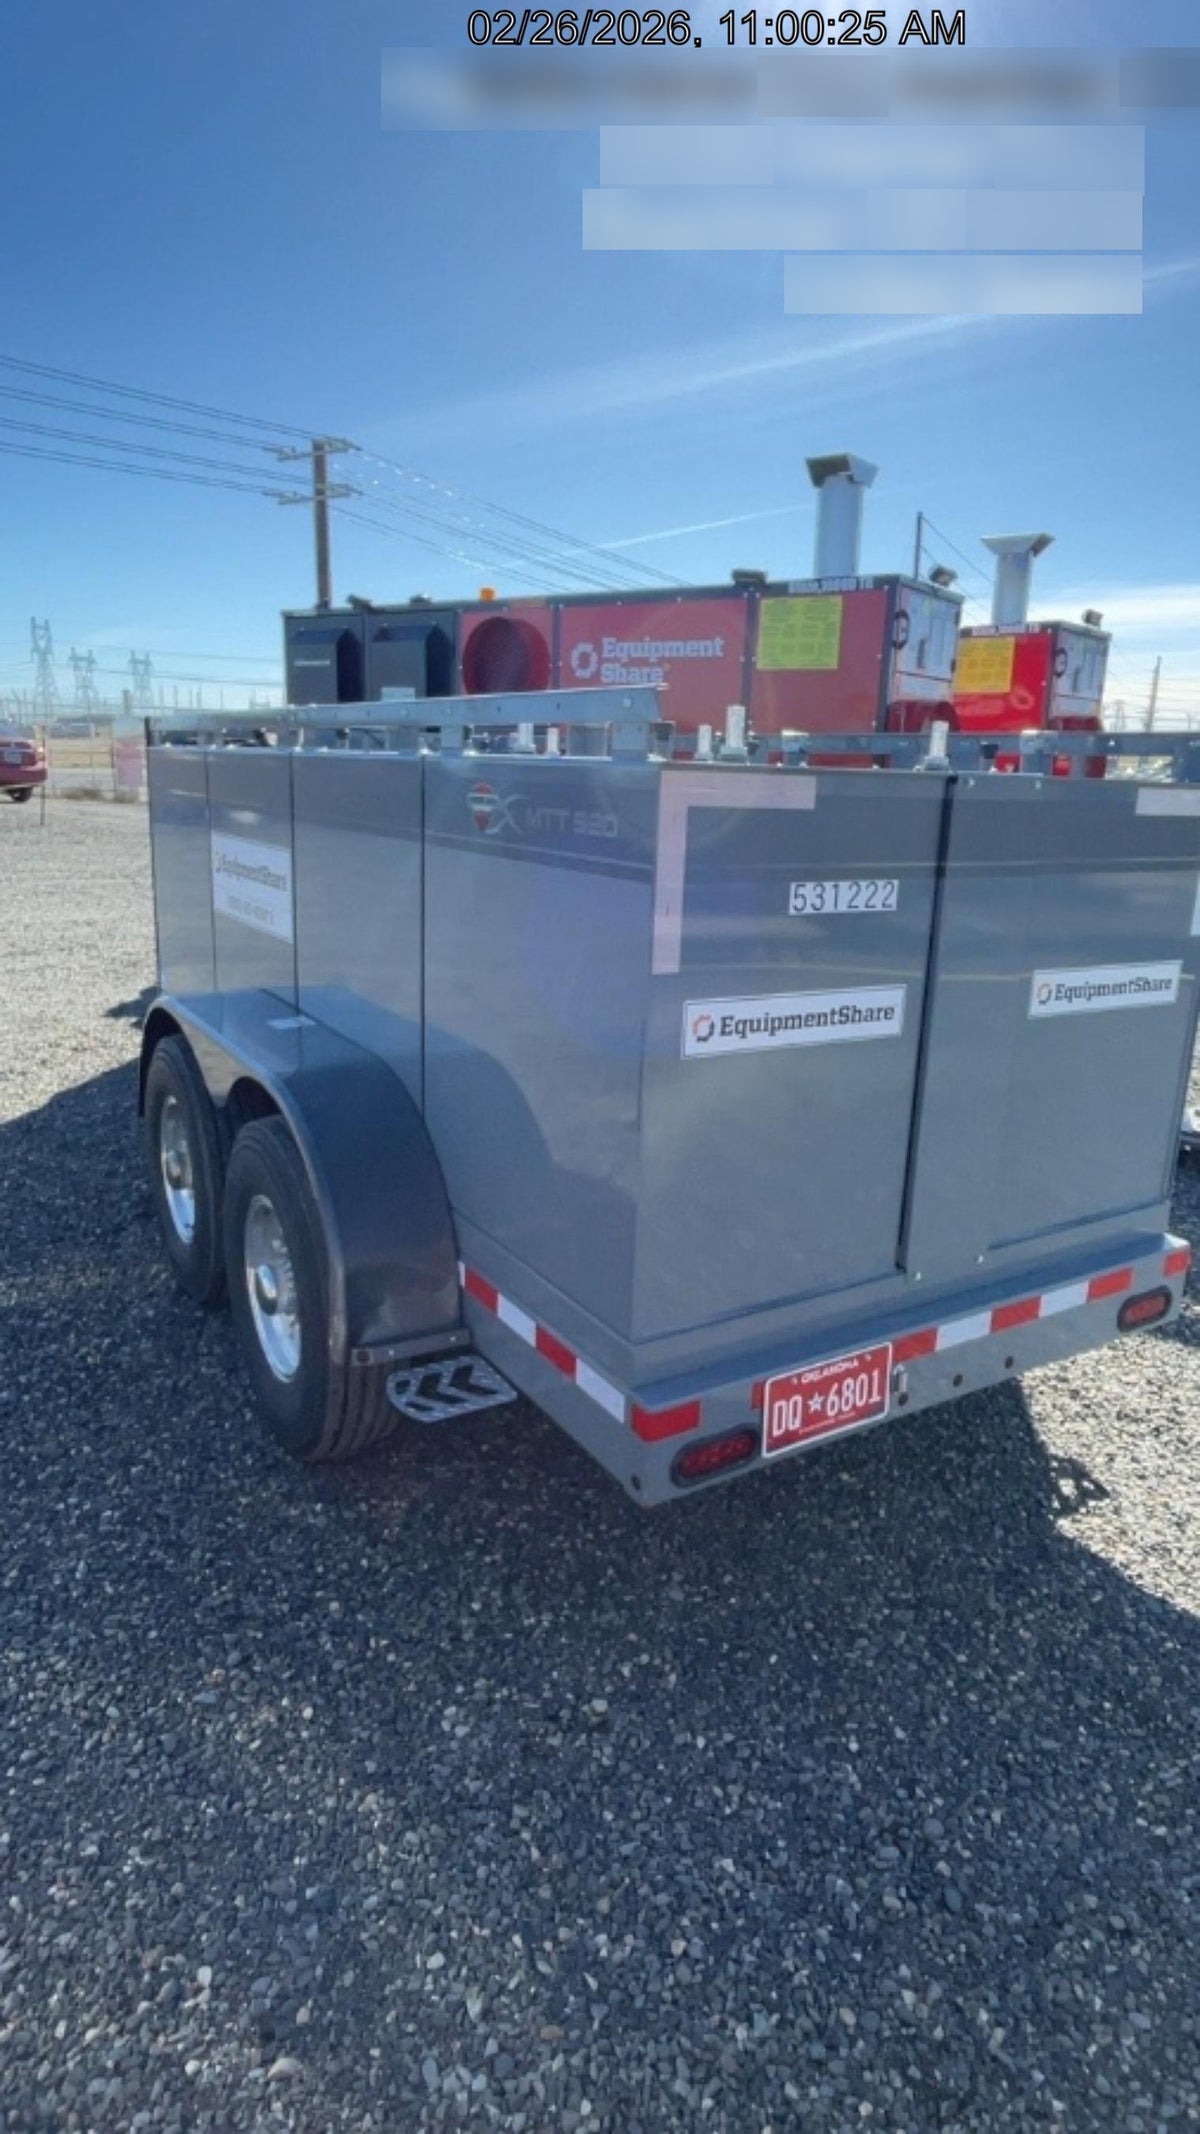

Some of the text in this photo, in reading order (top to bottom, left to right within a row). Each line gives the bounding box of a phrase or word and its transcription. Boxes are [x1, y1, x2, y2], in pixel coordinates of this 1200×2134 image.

[601, 637, 724, 662] Equipment
[601, 663, 665, 683] Share
[791, 880, 897, 913] 531222
[1053, 976, 1173, 1002] EquipmentShare
[719, 1004, 895, 1038] EquipmentShare
[826, 1368, 882, 1417] 6801
